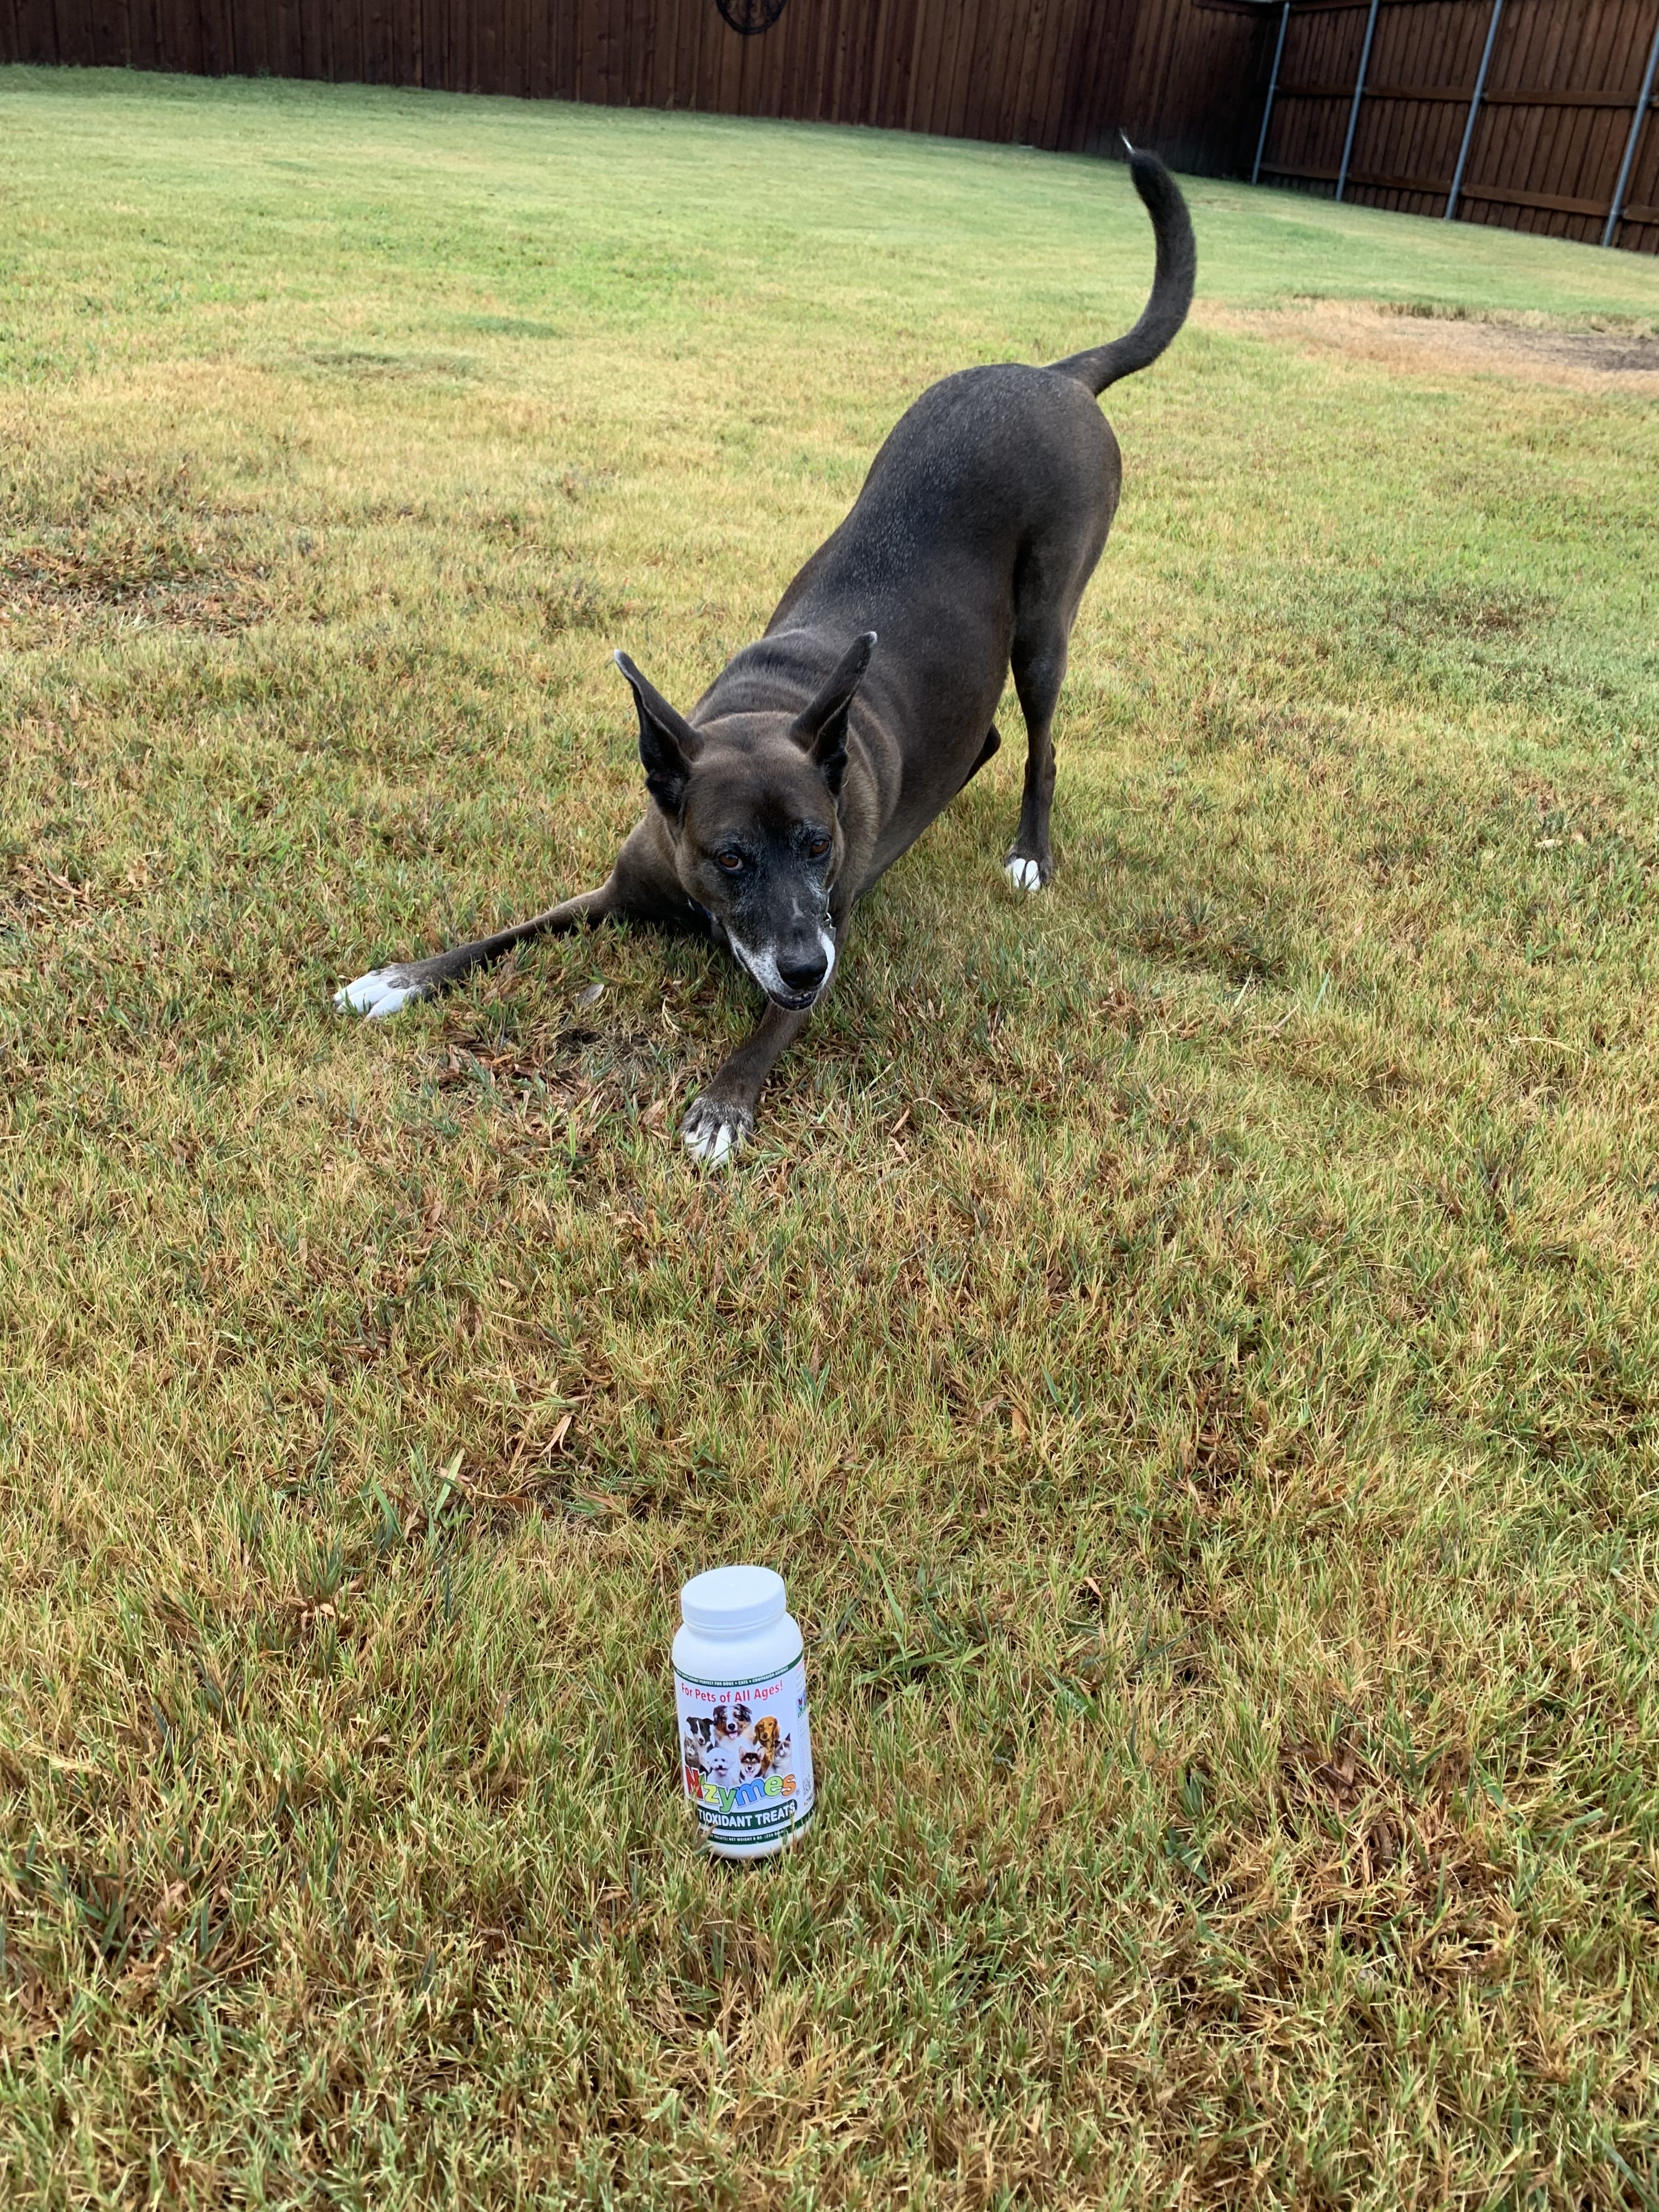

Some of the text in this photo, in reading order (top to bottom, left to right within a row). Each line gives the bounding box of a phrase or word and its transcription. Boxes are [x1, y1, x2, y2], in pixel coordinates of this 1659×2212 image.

[681, 1683, 693, 1697] For
[695, 1689, 716, 1702] Pets
[720, 1691, 731, 1702] of
[735, 1690, 751, 1702] All
[754, 1680, 783, 1700] Ages!
[698, 1803, 795, 1827] TIOXIDANT TREATS
